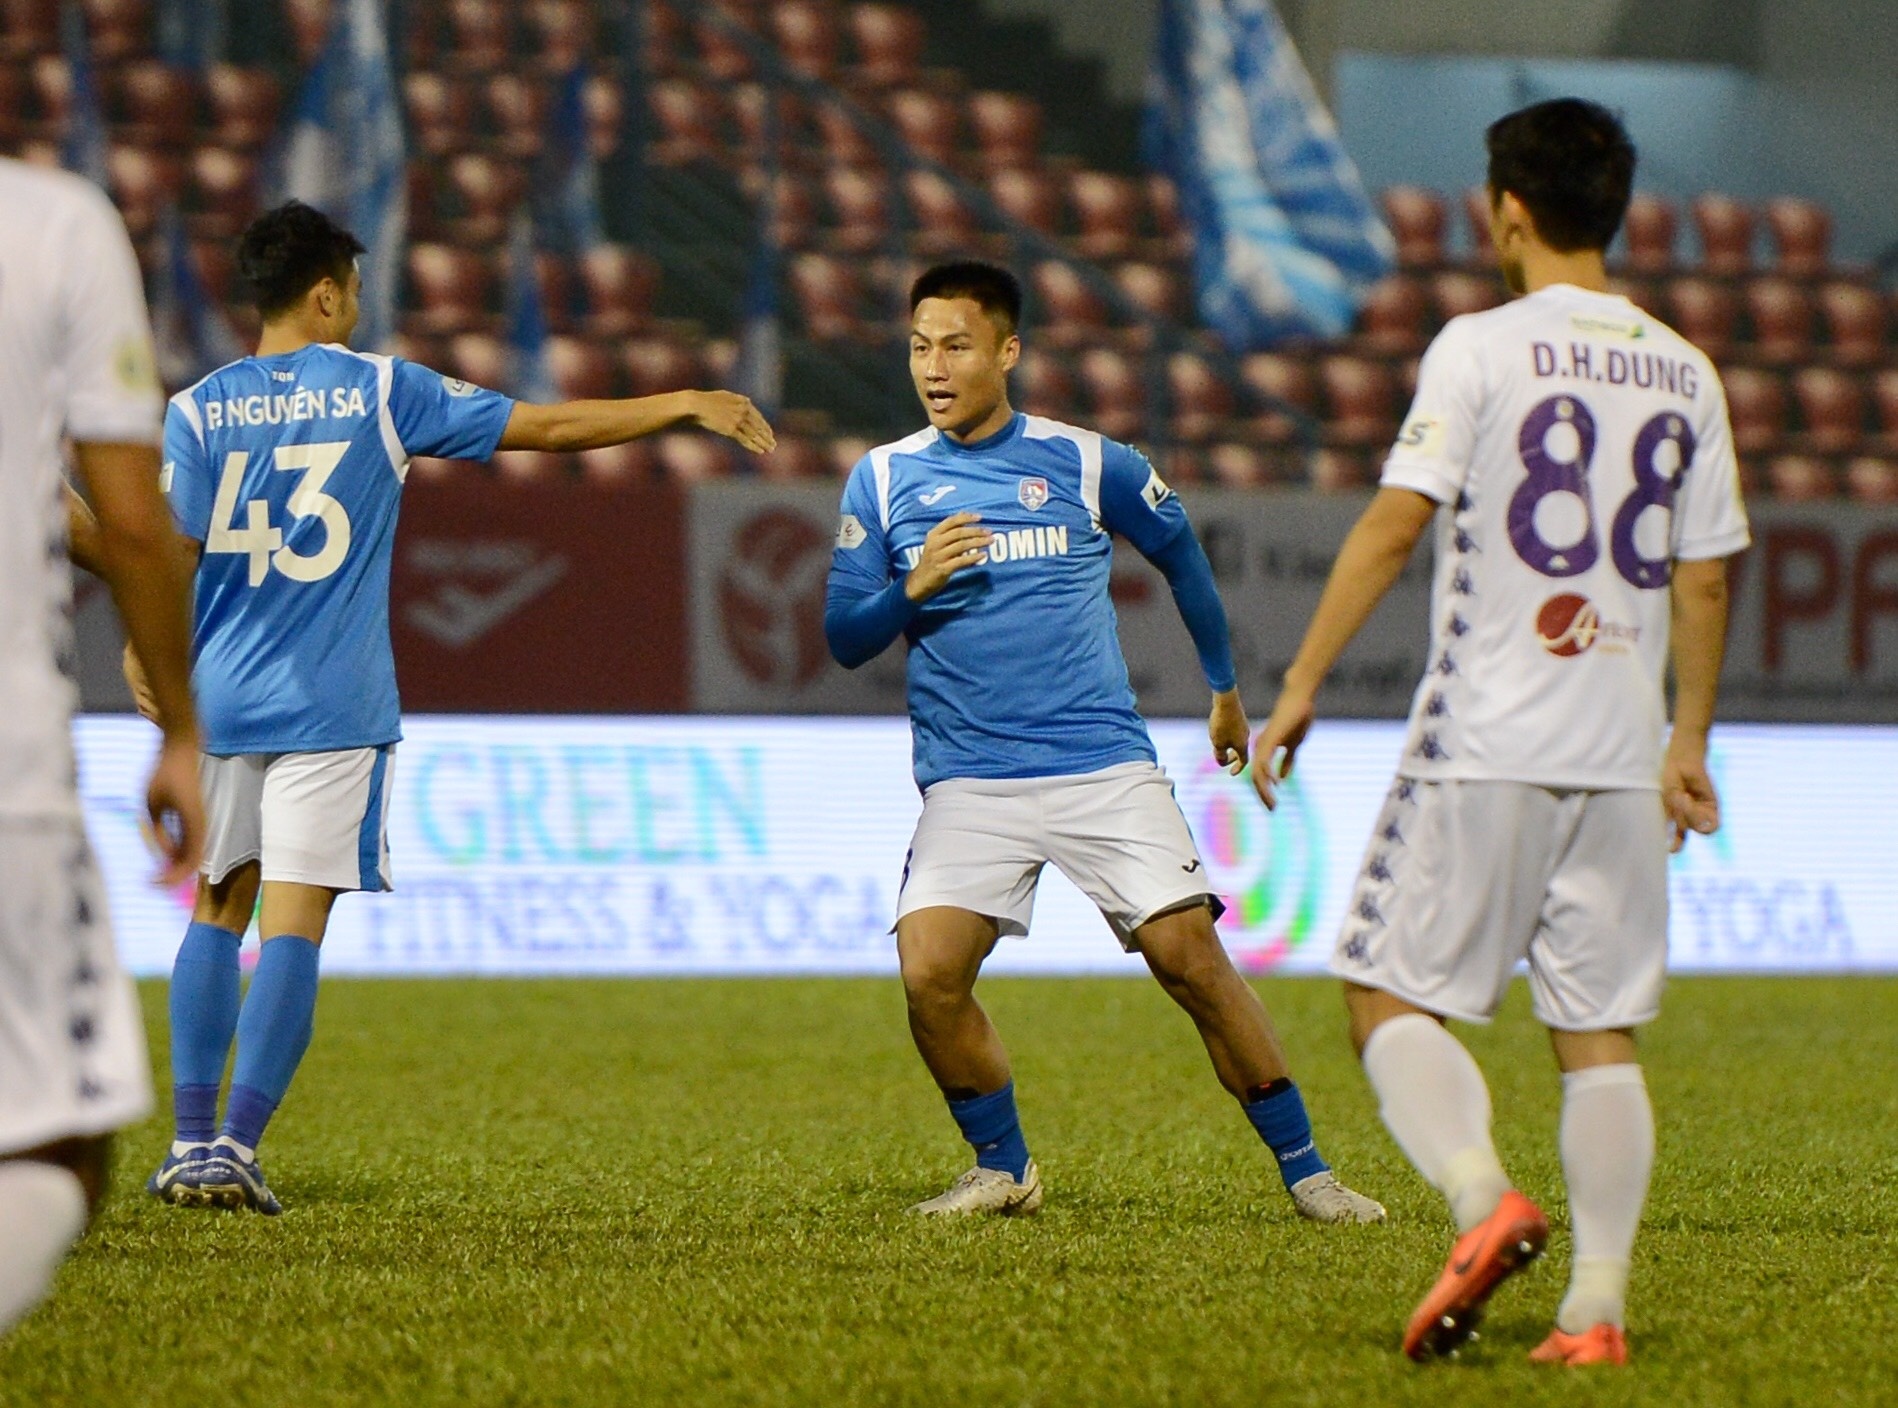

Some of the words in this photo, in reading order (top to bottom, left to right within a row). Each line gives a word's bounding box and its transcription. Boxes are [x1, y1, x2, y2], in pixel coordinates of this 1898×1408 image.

[331, 387, 366, 418] SA
[1533, 341, 1697, 398] D.H.DUNG
[206, 440, 352, 587] 43
[1507, 393, 1697, 590] 88
[412, 743, 767, 866] GREEN
[708, 876, 889, 954] YOGA
[1678, 874, 1856, 957] YOGA
